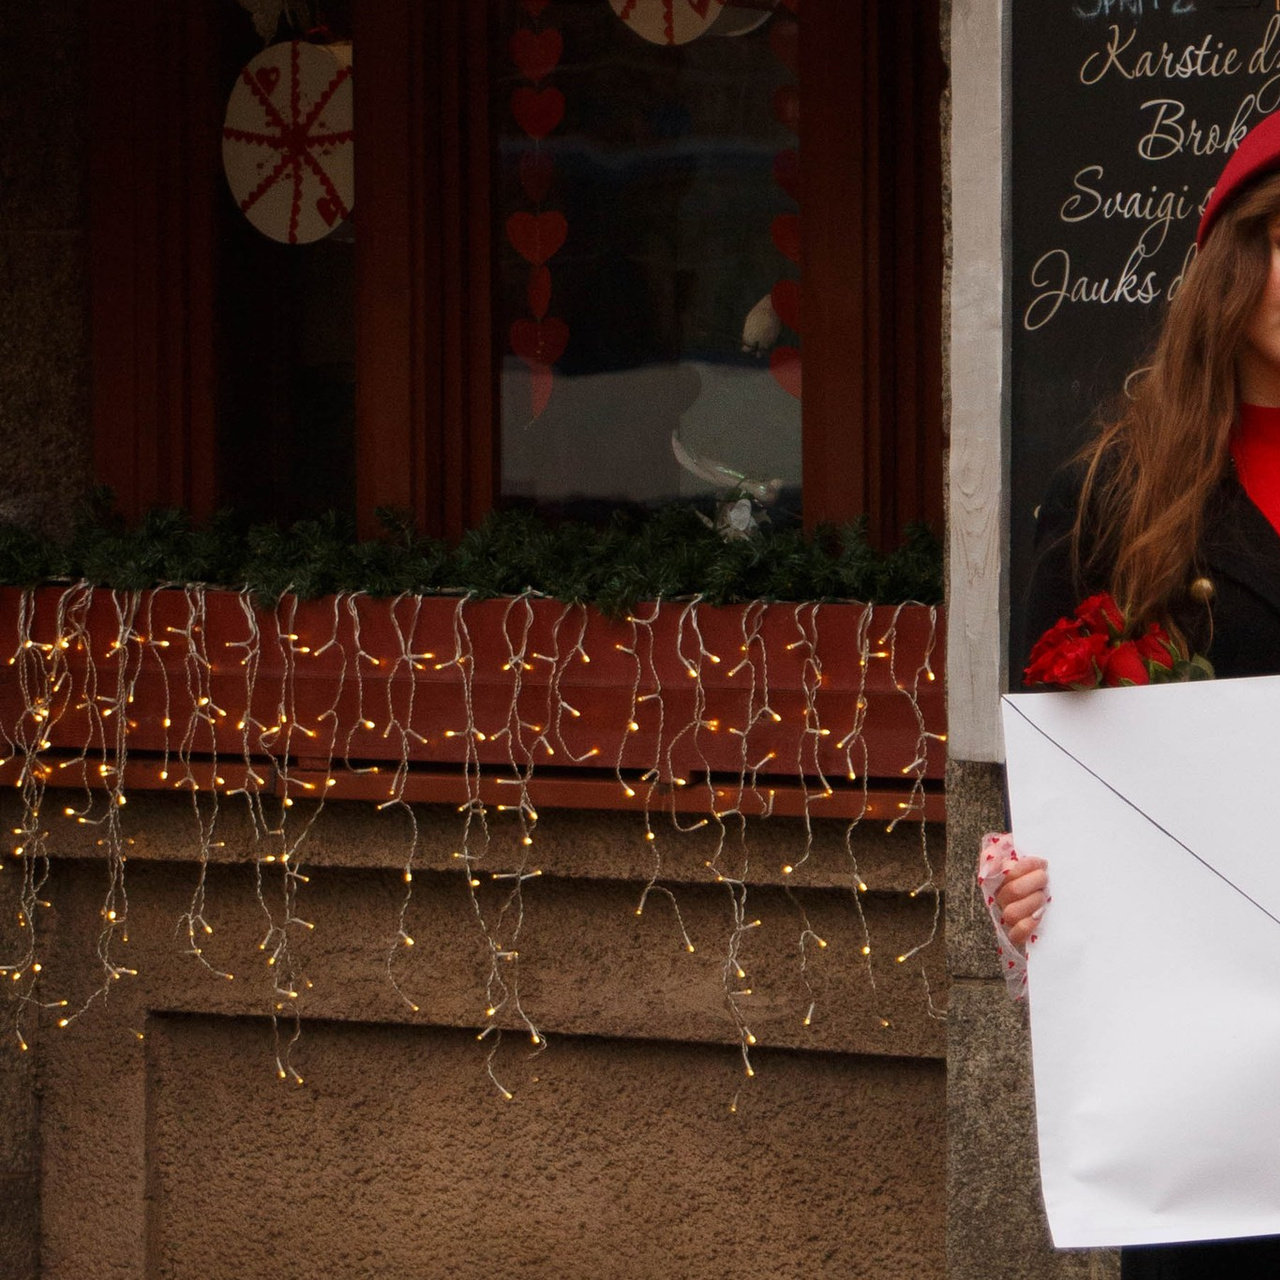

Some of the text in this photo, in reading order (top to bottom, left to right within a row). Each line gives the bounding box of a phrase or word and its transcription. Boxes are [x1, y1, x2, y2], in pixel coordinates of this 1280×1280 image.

[1080, 23, 1243, 85] Karstie
[1060, 165, 1194, 257] Svaigi
[1024, 243, 1162, 331] Jauks
